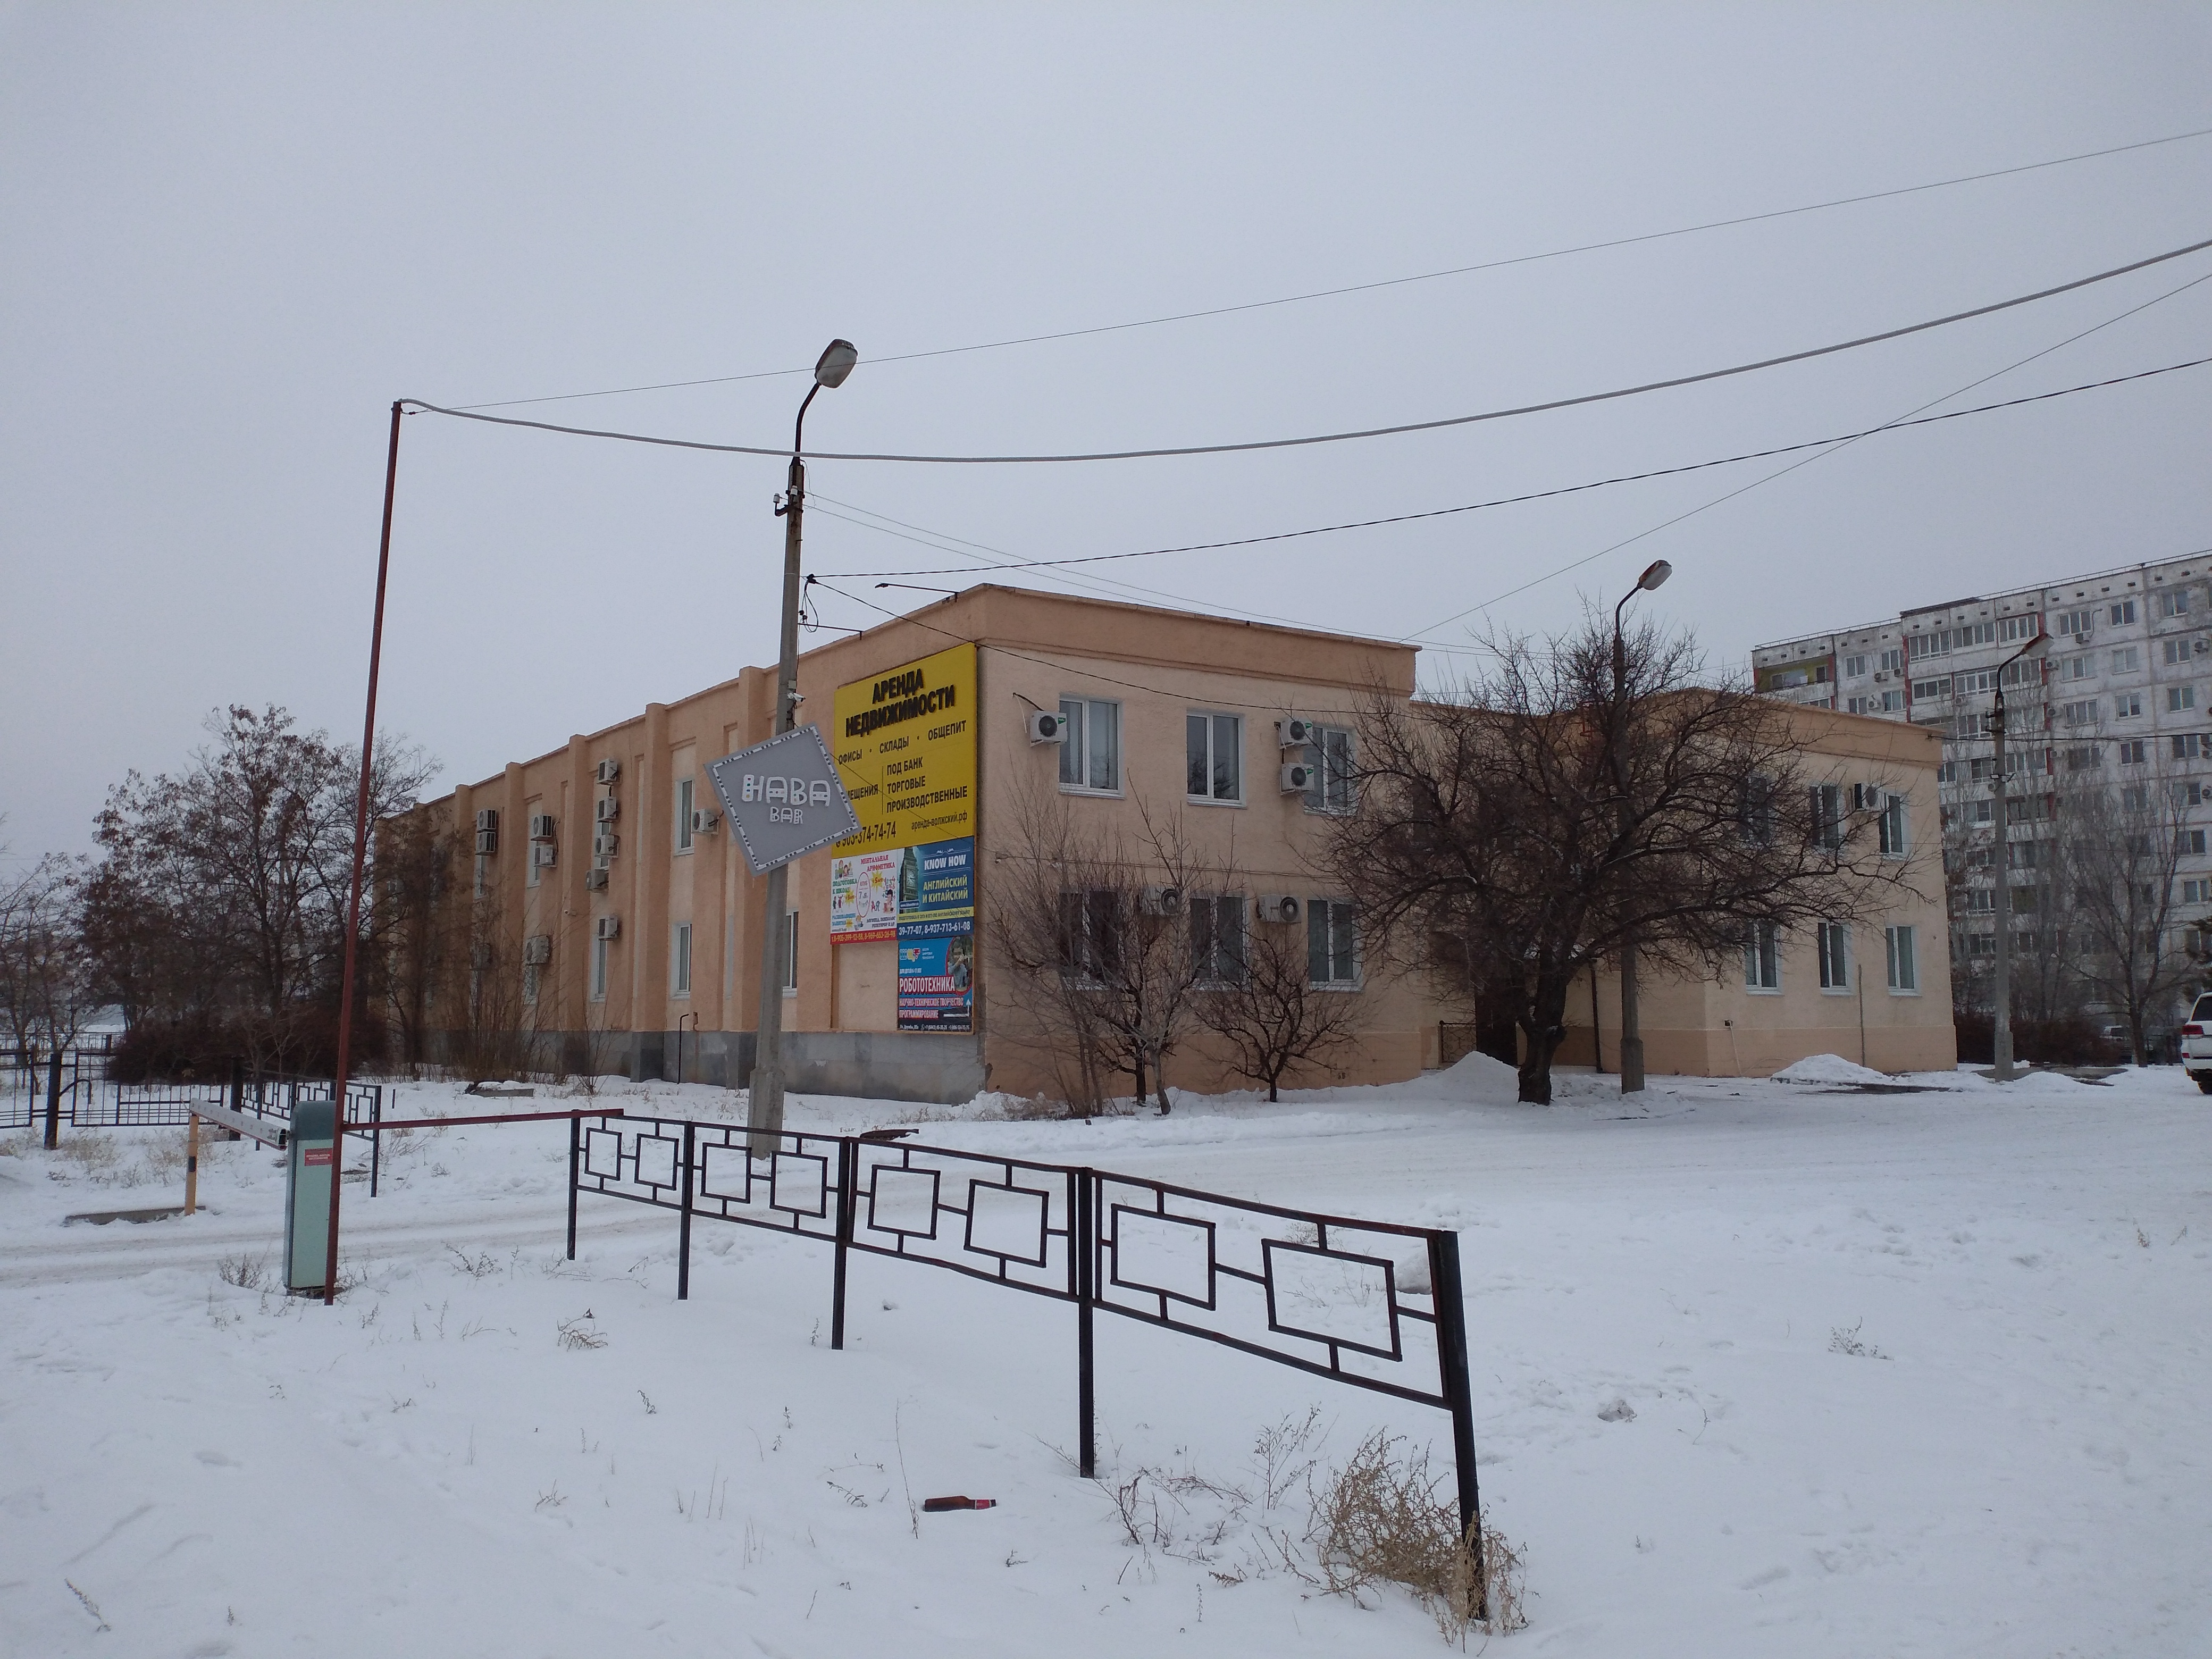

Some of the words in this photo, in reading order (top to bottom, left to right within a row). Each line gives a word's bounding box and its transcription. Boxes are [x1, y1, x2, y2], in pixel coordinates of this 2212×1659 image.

[872, 668, 924, 705] АРЕНДА
[845, 685, 955, 738] НЕДВИЖИМОСТИ
[838, 749, 862, 766] ОФИСЫ
[879, 736, 909, 754] СКЛАДЫ
[928, 720, 967, 741] ОБЩЕПИТ
[887, 762, 902, 776] ПОД
[904, 757, 923, 772] БАНК
[887, 775, 926, 795] ТОРГОВЫЕ
[887, 786, 968, 814] ПРОИЗВОДСТВЕННЫЕ
[911, 810, 968, 832] аренда-волжский.рф
[860, 854, 889, 865] МЕНТАЛЬНАЯ
[866, 862, 895, 872] АРИФМЕТИКА
[924, 857, 947, 870] KNOW
[948, 854, 967, 867] HOW
[923, 875, 968, 891] АНГЛИЙСКИЙ
[923, 894, 927, 903] И
[928, 887, 968, 903] КИТАЙСКИЙ
[899, 925, 924, 936] 39-77-07,
[924, 921, 970, 934] 8-937-713-61-08
[899, 977, 956, 993] РОБОТОТЕХНИКА
[899, 998, 940, 1007] НАУЧНО-ТЕХНИЧЕСКОЕ
[940, 997, 963, 1007] ТВОРЧЕСТВО
[899, 1009, 939, 1019] ПРОГРАММИРОВАНИЕ
